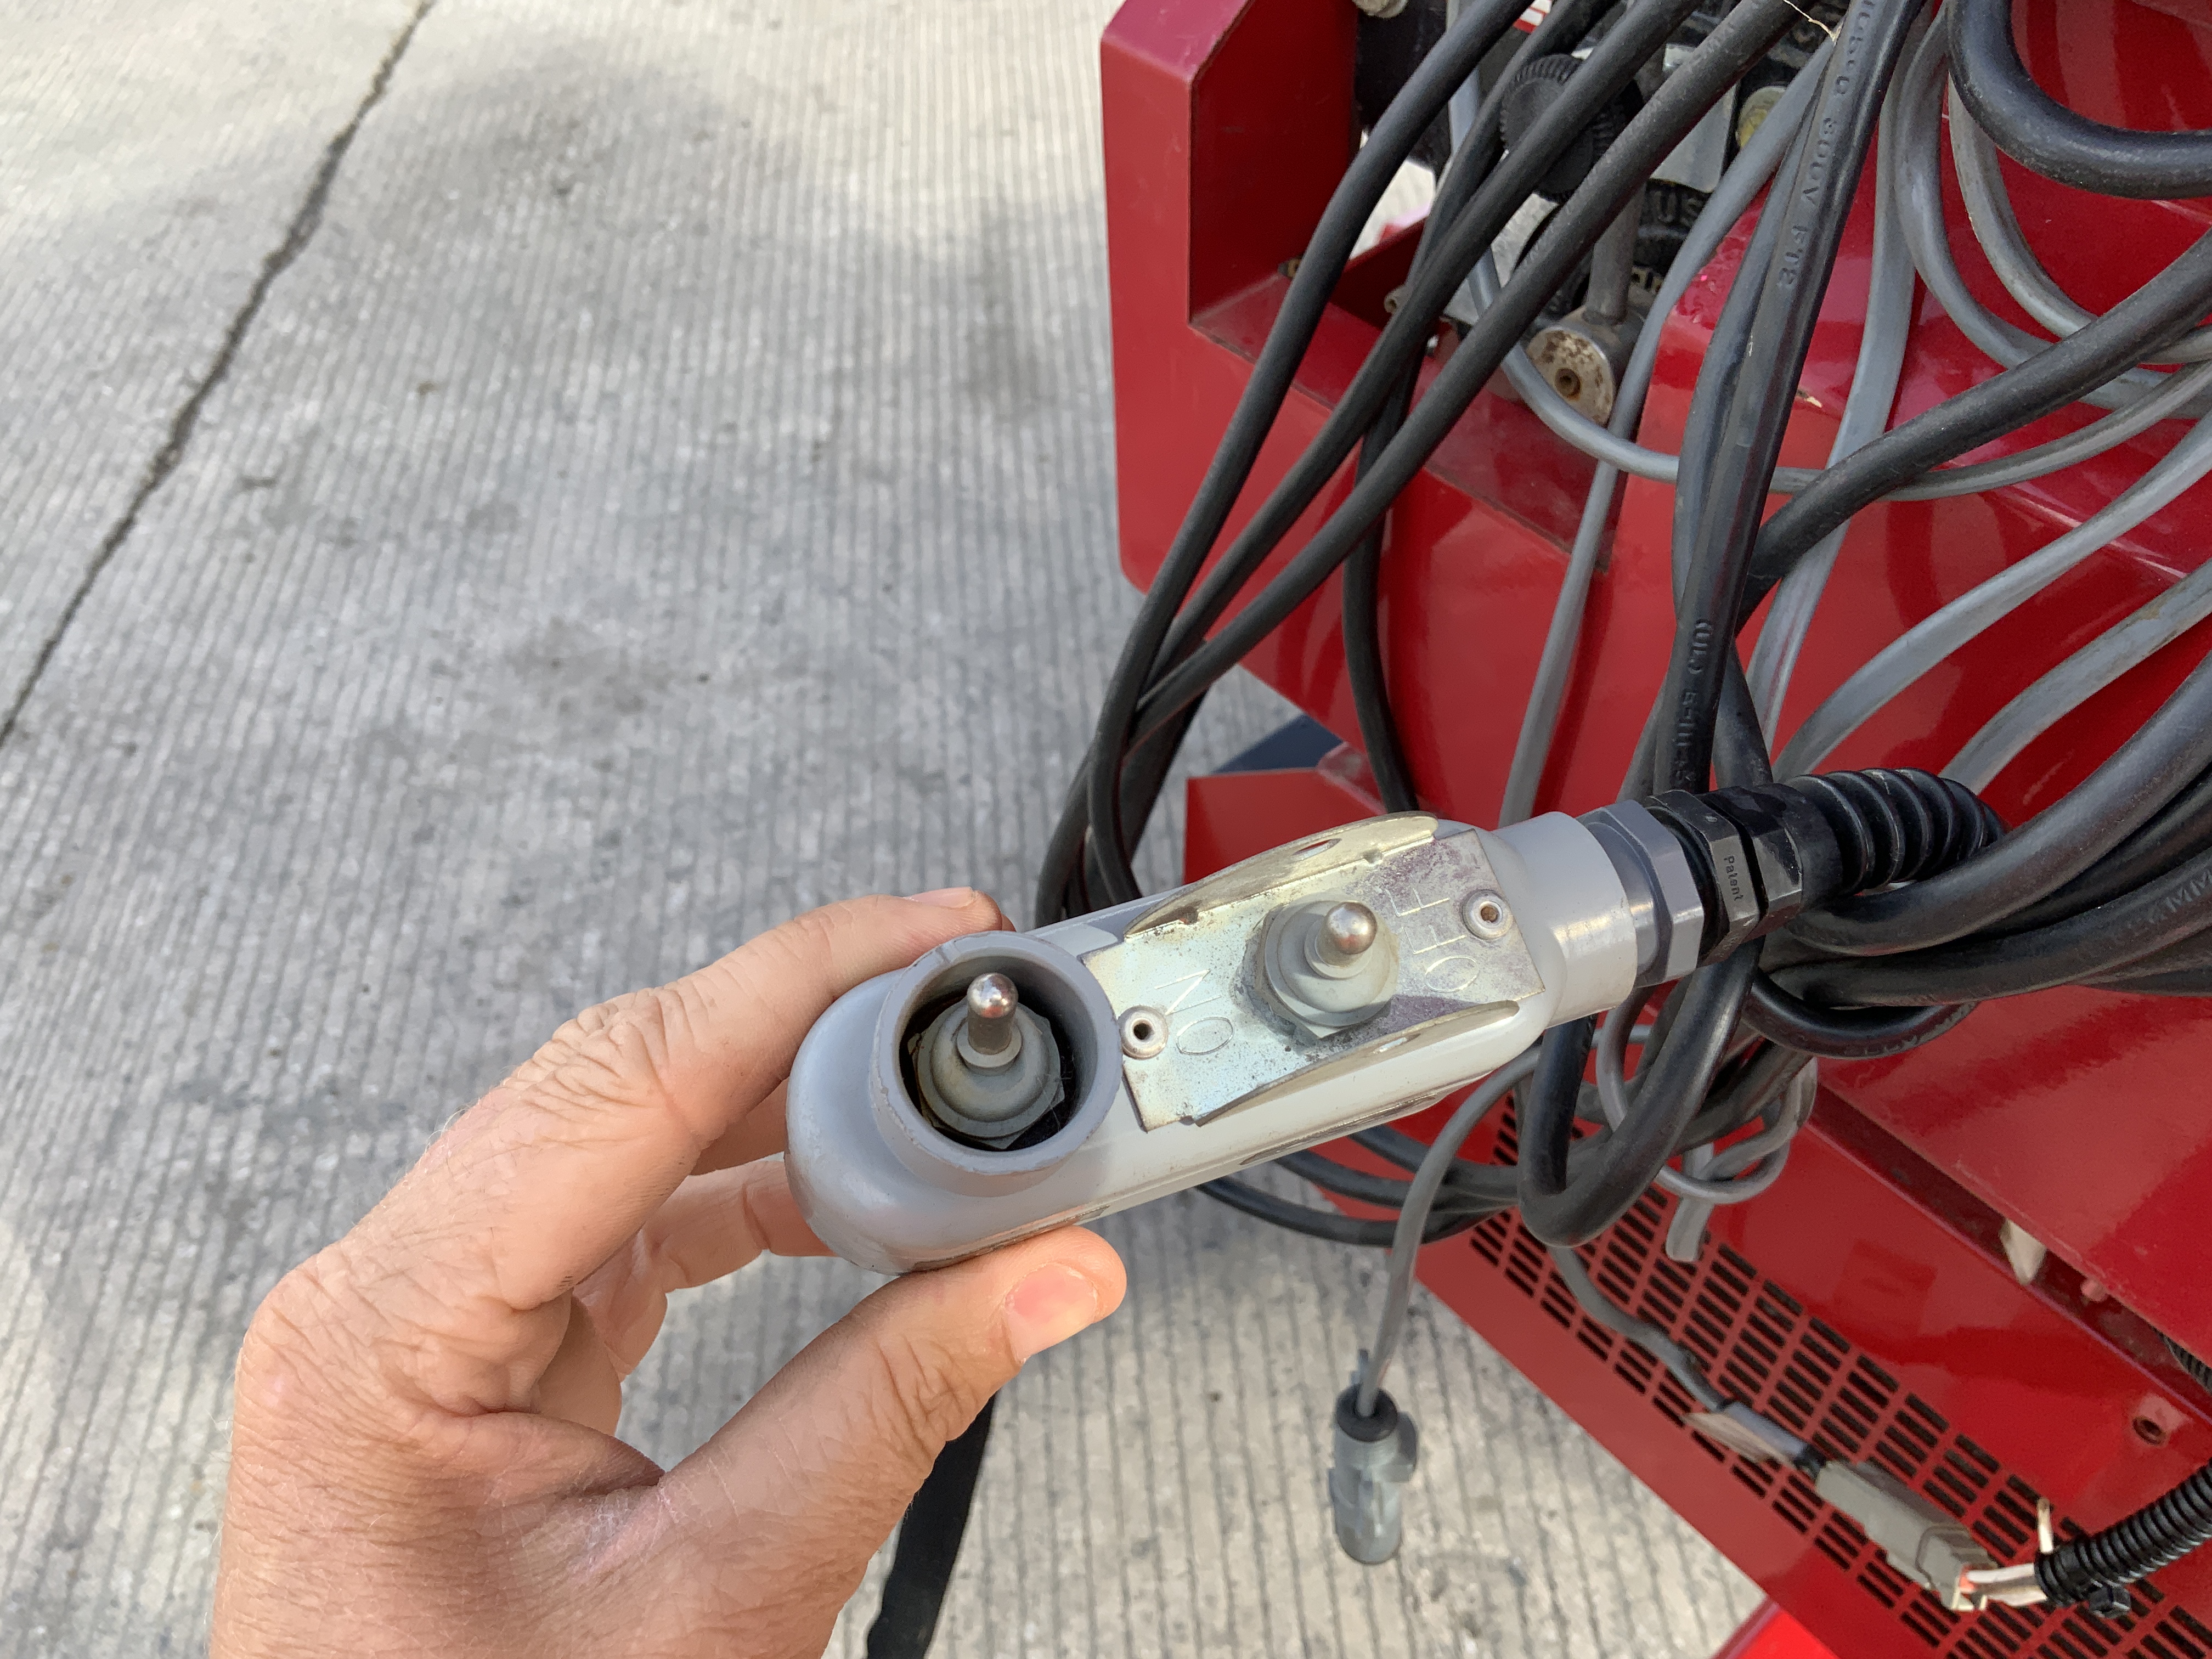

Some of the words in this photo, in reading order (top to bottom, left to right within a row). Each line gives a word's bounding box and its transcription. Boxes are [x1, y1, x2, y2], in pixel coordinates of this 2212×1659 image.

[1724, 855, 1743, 901] Patent
[1385, 887, 1480, 993] OFF
[1154, 968, 1233, 1056] ON
